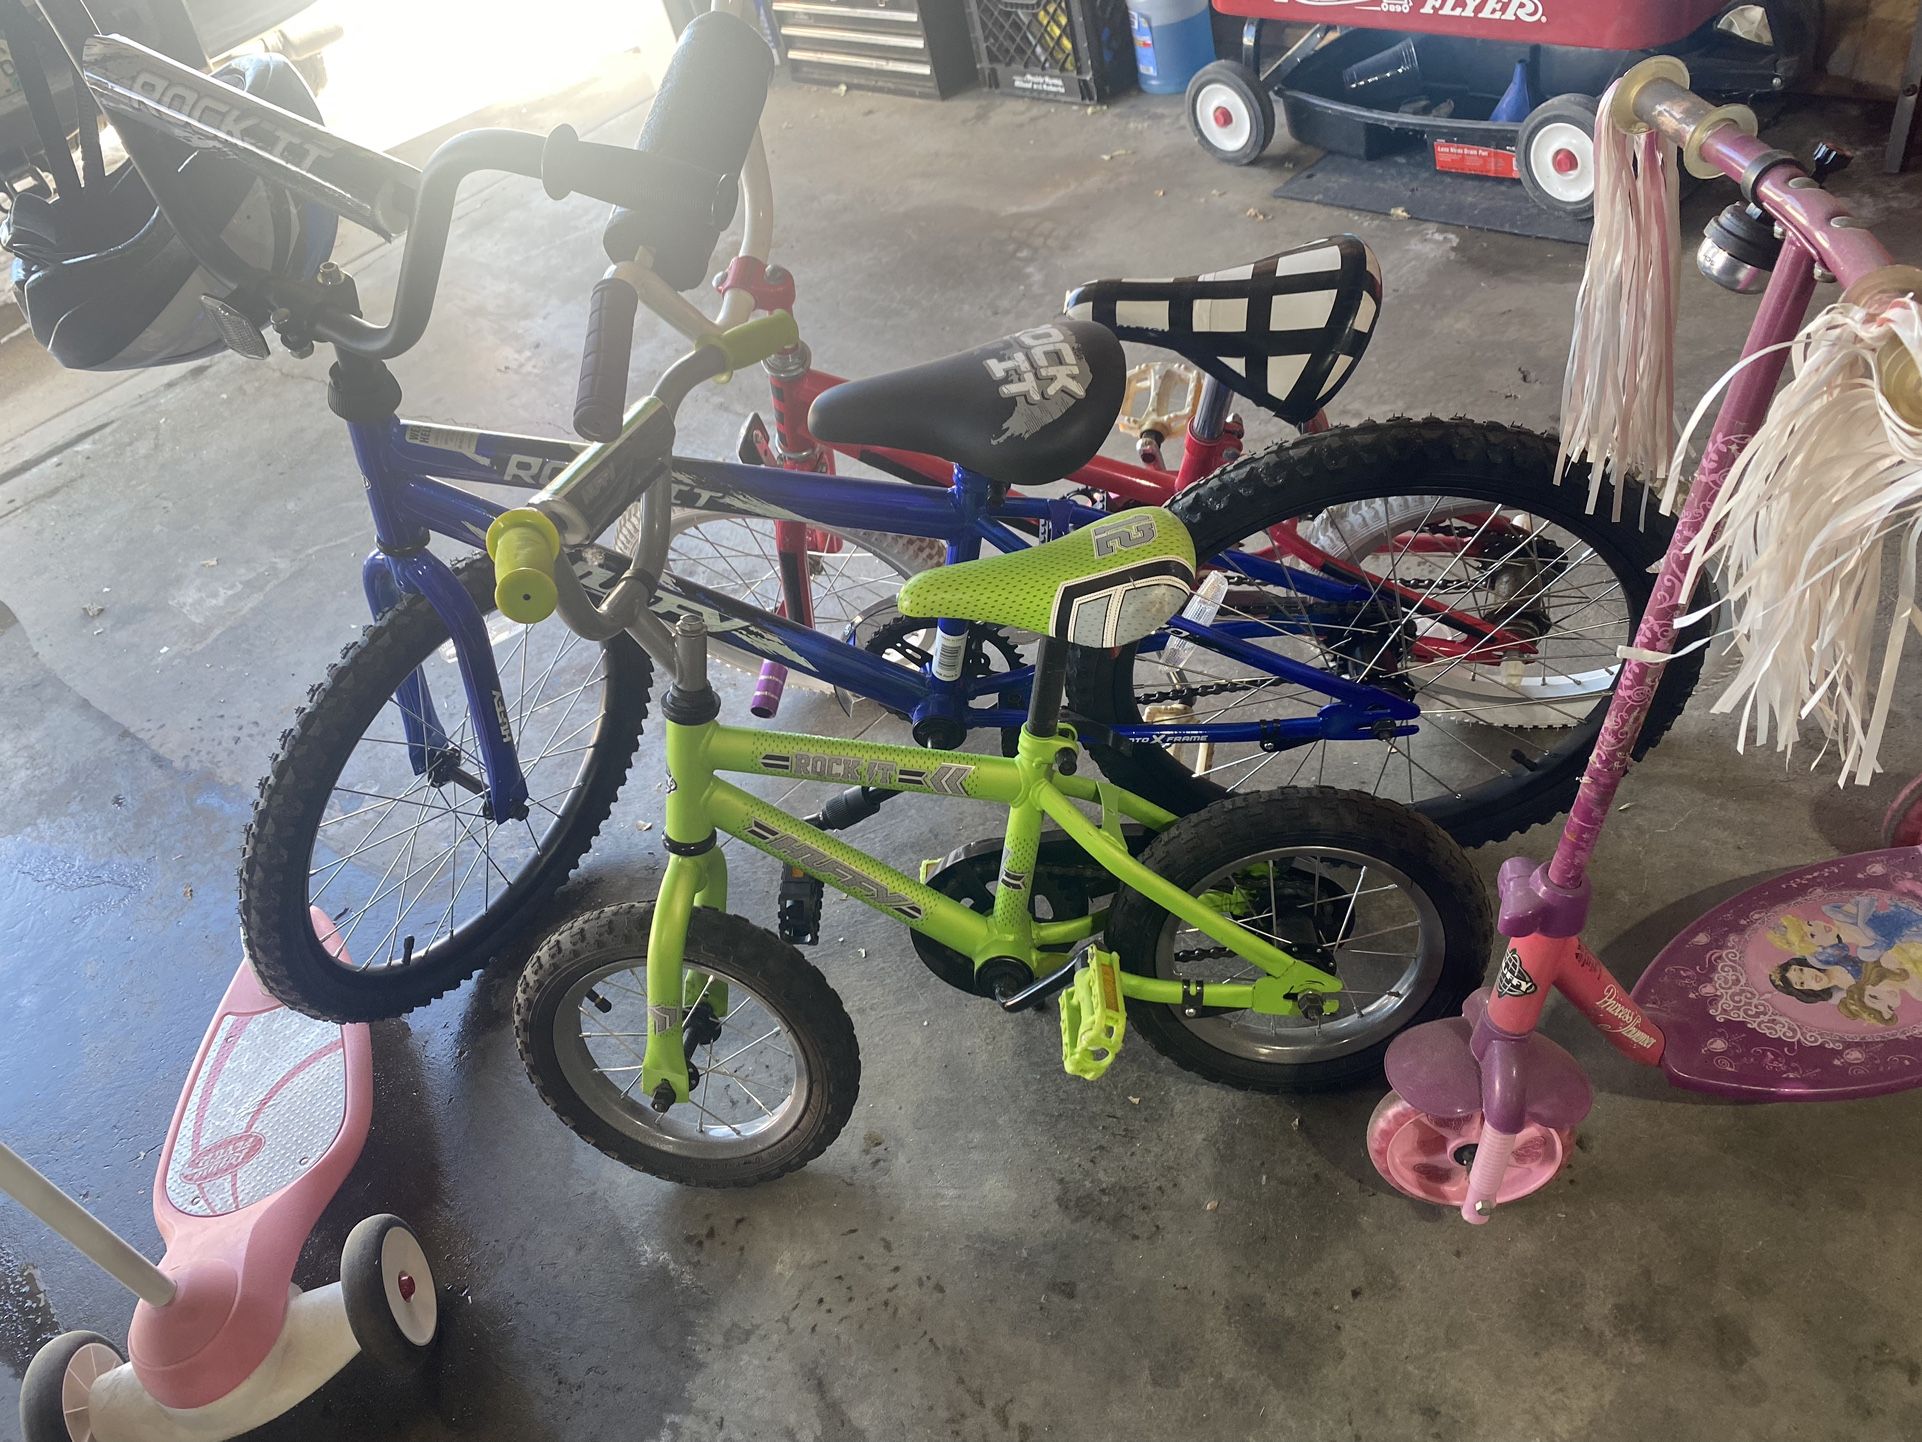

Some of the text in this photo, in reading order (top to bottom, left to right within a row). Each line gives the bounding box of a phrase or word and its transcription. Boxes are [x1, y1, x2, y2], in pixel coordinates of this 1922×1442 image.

[1419, 0, 1543, 23] FLYER
[984, 351, 1041, 401] IT
[1091, 514, 1158, 559] 12
[491, 689, 511, 743] HUFFY
[1150, 734, 1166, 744] X
[793, 752, 860, 782] ROCK
[768, 832, 914, 908] HUFFY
[1596, 984, 1634, 1024] Princess
